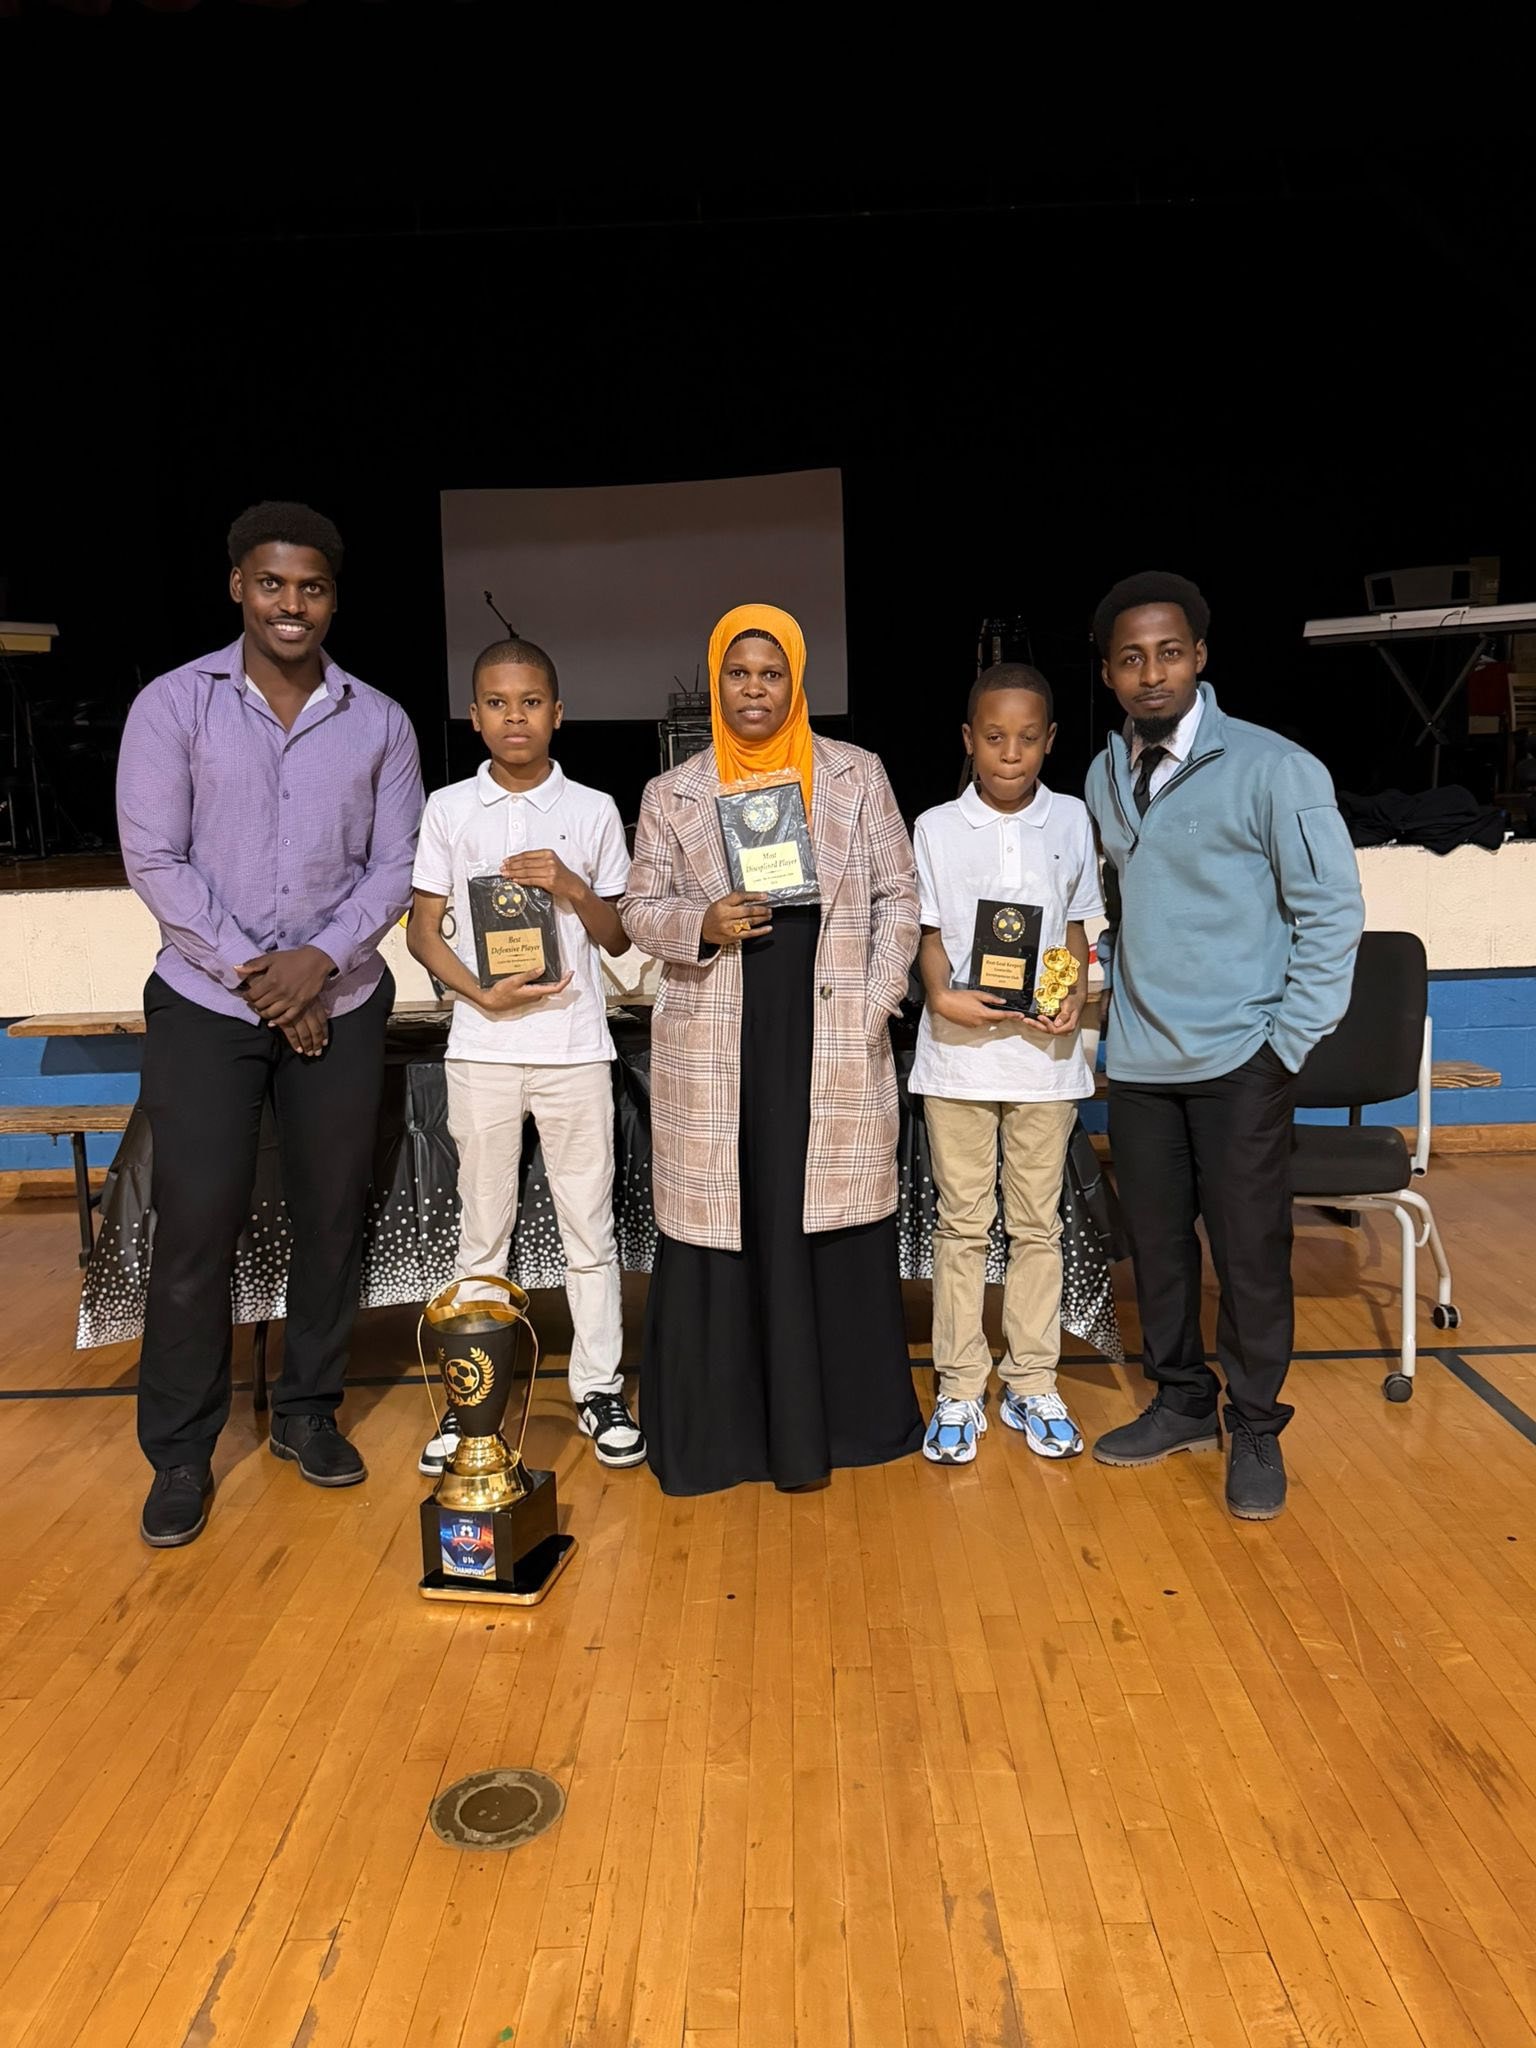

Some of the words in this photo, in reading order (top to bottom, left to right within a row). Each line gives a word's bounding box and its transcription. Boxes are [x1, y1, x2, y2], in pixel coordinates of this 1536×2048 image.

[762, 852, 777, 860] Most
[778, 859, 797, 867] Player
[508, 936, 521, 944] Best
[491, 946, 520, 955] Defensive
[521, 944, 540, 952] Player
